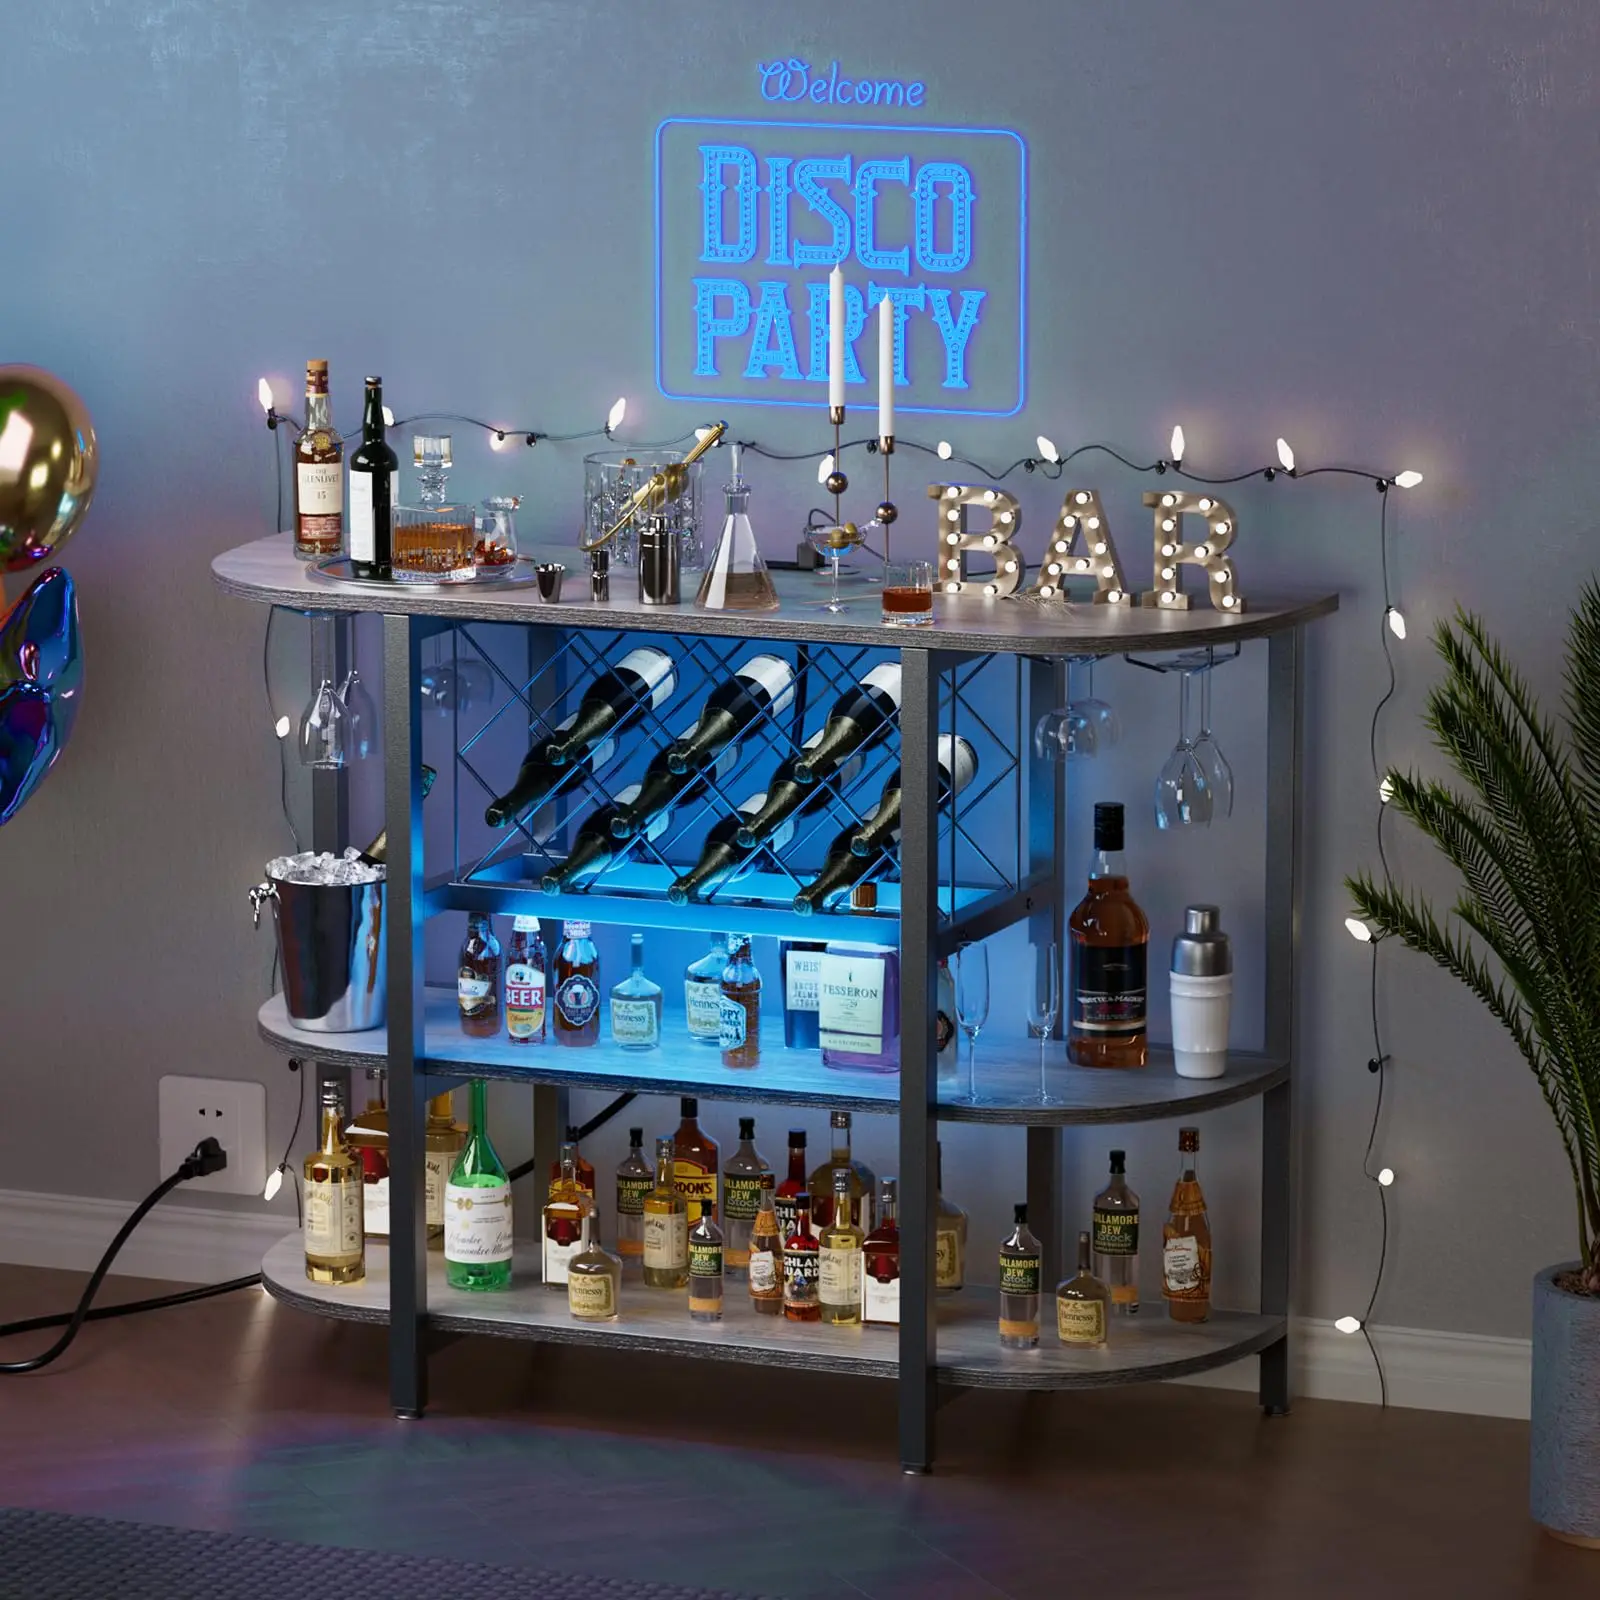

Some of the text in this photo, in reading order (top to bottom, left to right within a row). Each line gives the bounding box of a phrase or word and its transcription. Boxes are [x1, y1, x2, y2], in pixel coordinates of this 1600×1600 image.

[758, 58, 925, 106] Welcome
[698, 144, 976, 276] DISCO
[692, 277, 987, 389] PARTY
[928, 482, 1248, 615] BAR
[506, 988, 542, 1006] BEER
[824, 984, 879, 999] TESSERON
[731, 1190, 750, 1200] DEW
[1101, 1225, 1121, 1235] DEW
[1006, 1267, 1024, 1277] DEW
